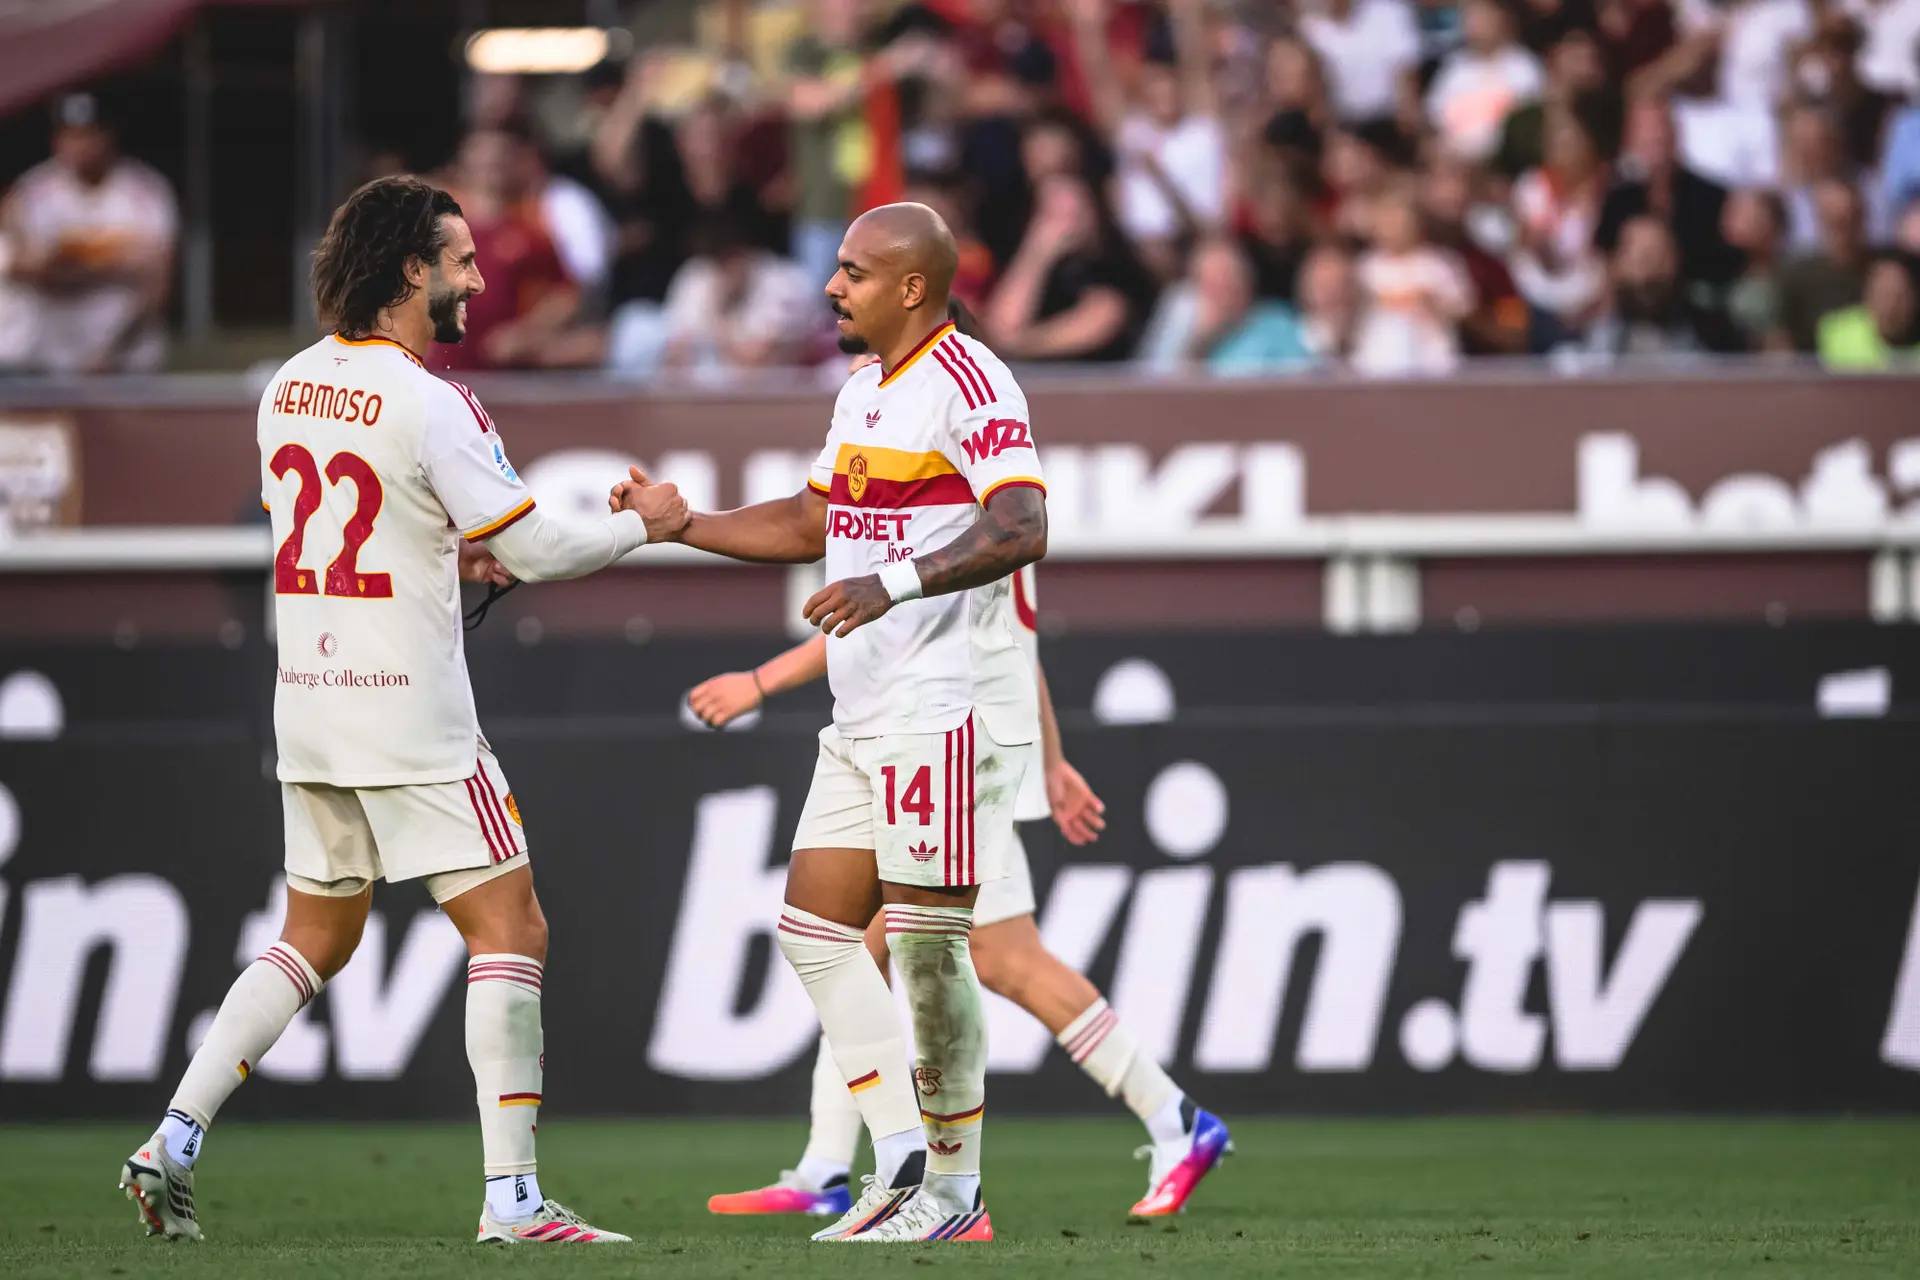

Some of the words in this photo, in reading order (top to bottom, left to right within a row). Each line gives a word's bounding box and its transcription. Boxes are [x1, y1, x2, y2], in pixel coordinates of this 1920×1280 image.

[272, 380, 383, 427] HERMOSO
[268, 442, 395, 599] 22
[824, 509, 912, 541] UROBET
[322, 669, 410, 687] Collection
[881, 765, 935, 827] 14
[646, 761, 1702, 1078] bin.tv
